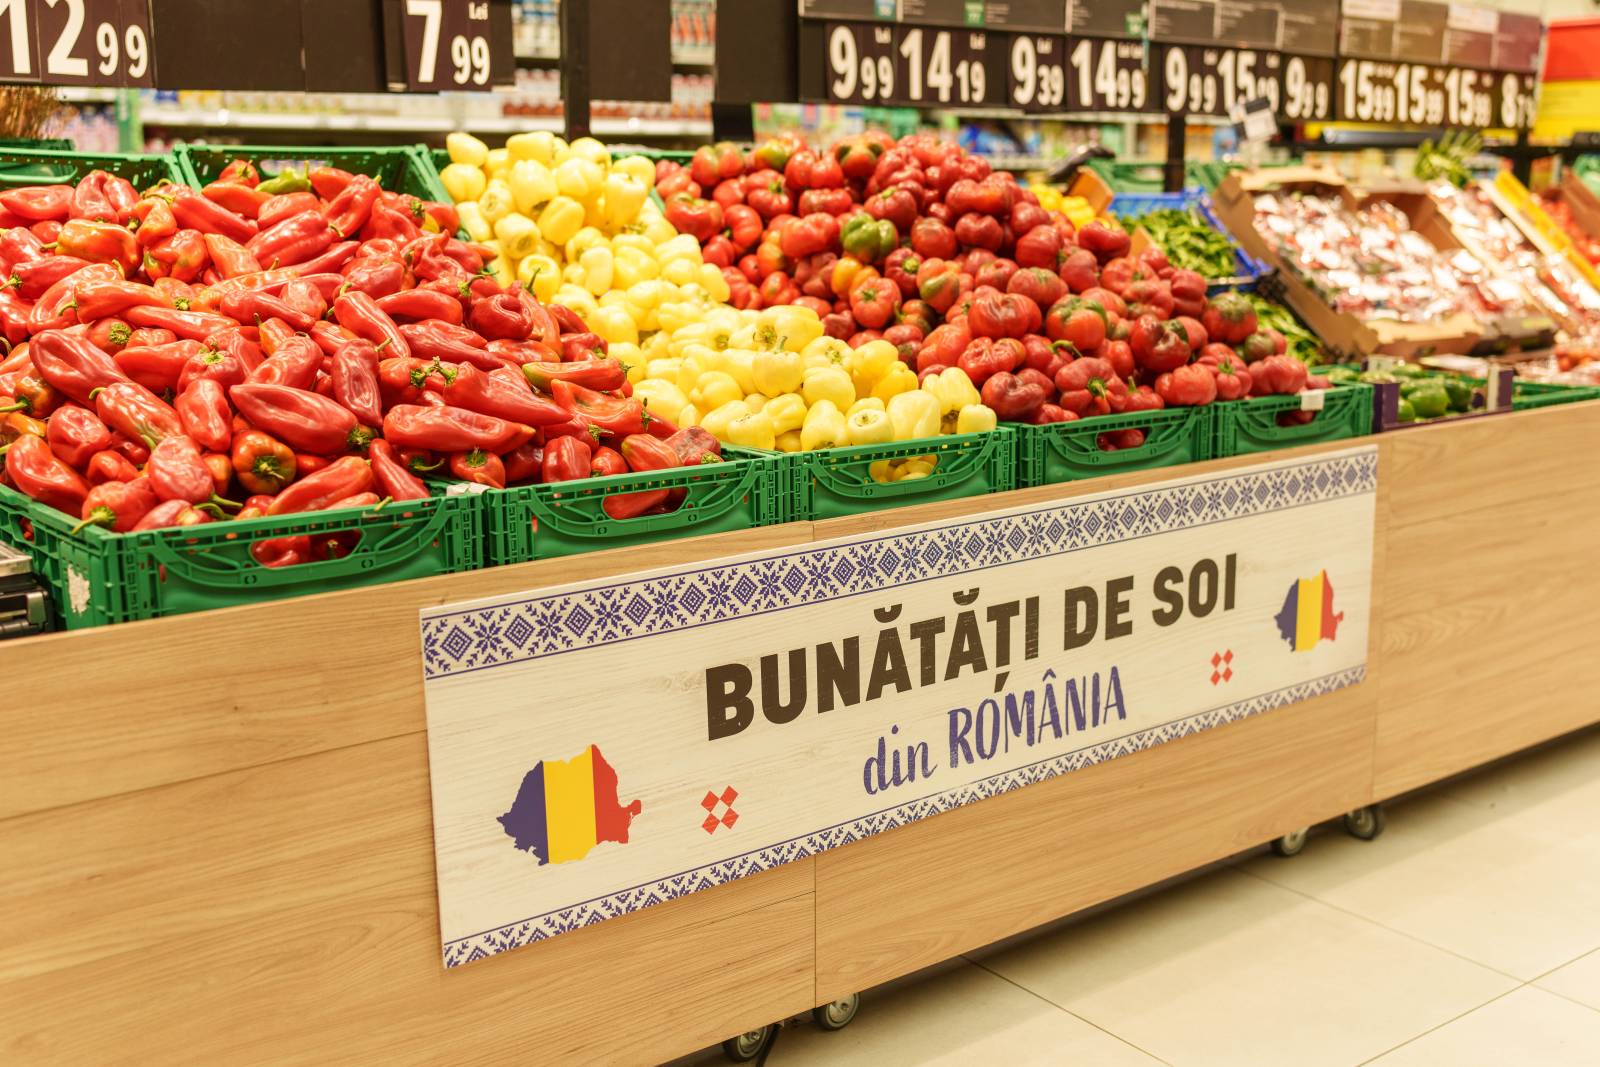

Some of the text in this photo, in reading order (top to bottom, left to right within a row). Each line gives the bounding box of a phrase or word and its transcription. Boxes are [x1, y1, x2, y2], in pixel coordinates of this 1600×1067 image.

[96, 22, 148, 78] 99
[406, 0, 490, 85] 7 99
[468, 2, 488, 20] Lei
[705, 552, 1238, 741] BUNĂTĂȚI DE SOI
[863, 665, 1127, 796] din ROMÂNIA
